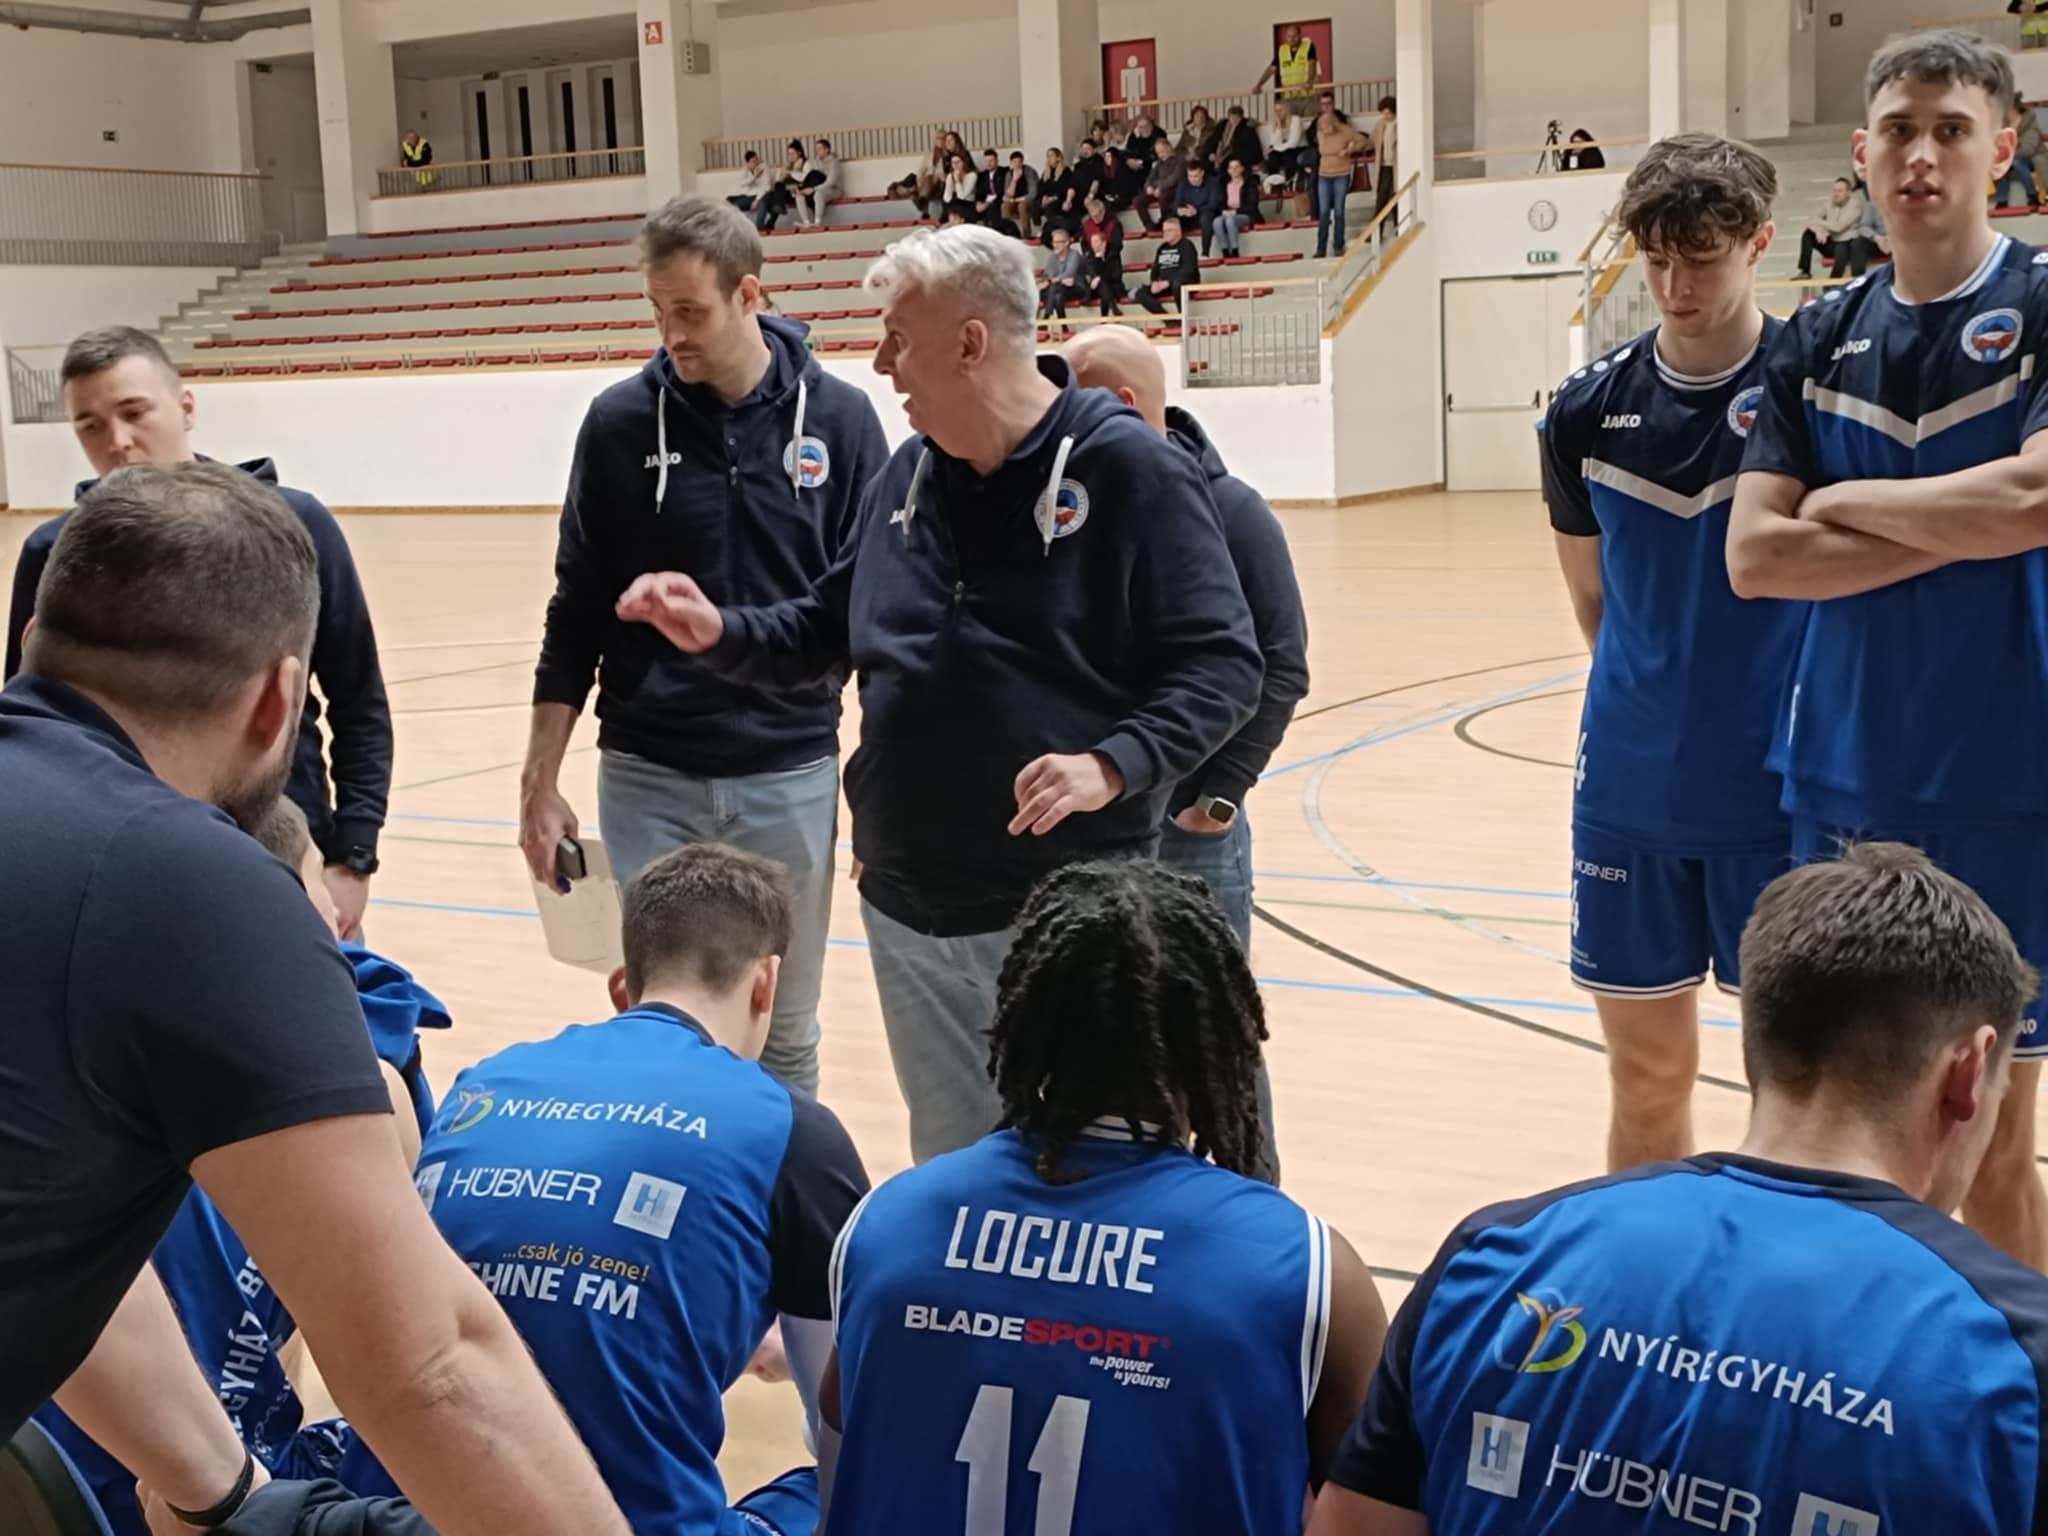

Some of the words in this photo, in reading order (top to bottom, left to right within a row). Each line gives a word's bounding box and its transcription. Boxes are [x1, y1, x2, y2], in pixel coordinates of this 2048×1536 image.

[647, 23, 660, 41] A
[1601, 414, 1642, 429] JAKO
[498, 1097, 707, 1140] NYÍREGYHÁZA
[447, 1167, 602, 1207] HÜBNER
[561, 1244, 584, 1268] jó
[589, 1253, 650, 1283] zene!
[944, 1205, 1165, 1294] LOCURE
[572, 1272, 640, 1320] FM
[1103, 1355, 1155, 1374] power
[1121, 1371, 1172, 1390] yours!
[1599, 1327, 1895, 1436] NYÍREGYHÁZA
[954, 1384, 1091, 1536] 11
[1545, 1443, 1762, 1536] HÜBNER
